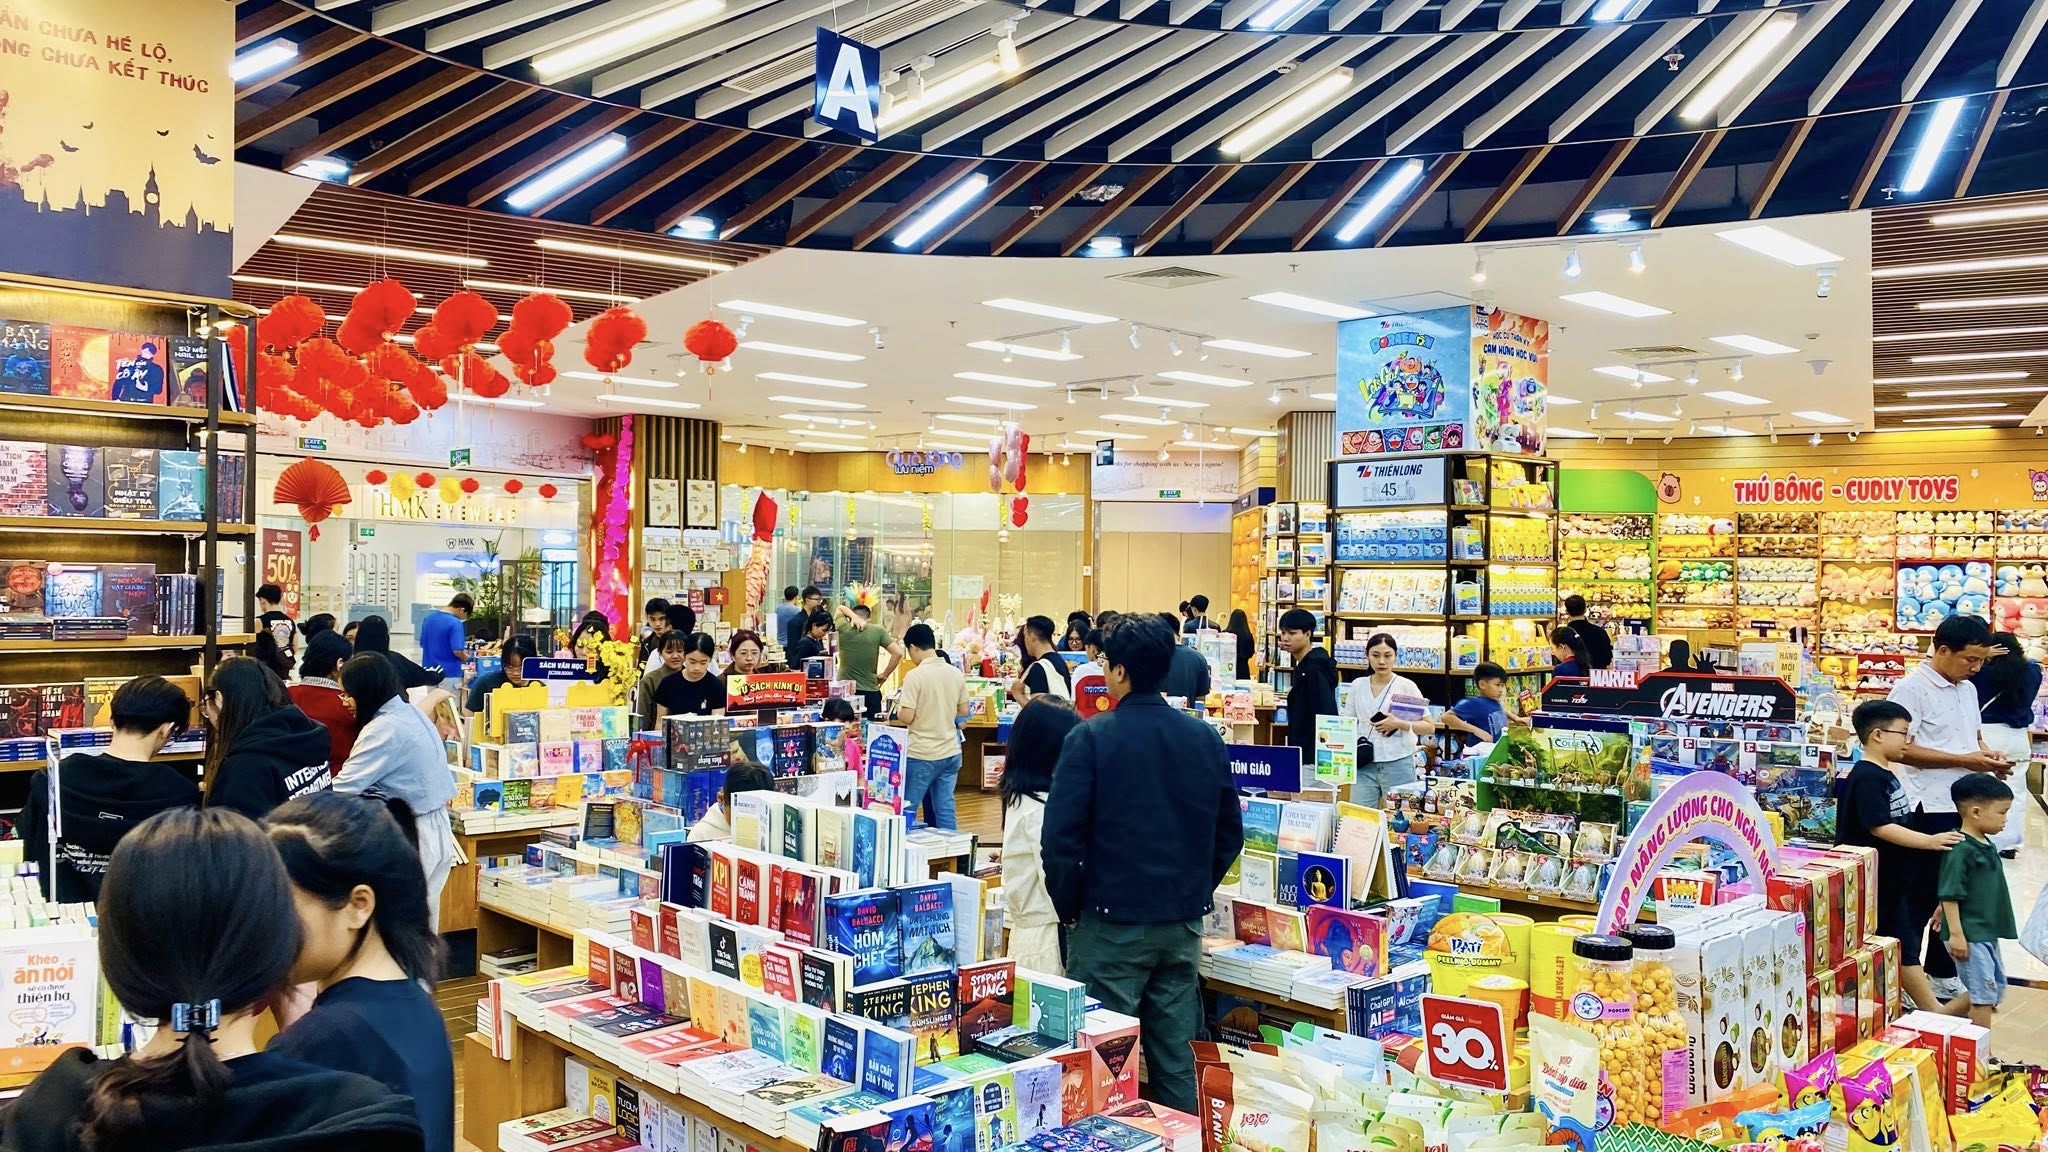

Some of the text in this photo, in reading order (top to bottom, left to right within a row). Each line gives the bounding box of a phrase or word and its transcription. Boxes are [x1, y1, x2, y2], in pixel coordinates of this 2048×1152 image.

[40, 20, 97, 45] CHƯA
[106, 33, 131, 53] HÉ
[41, 46, 209, 94] CHƯA KẾT THÚC
[820, 42, 876, 134] A
[1369, 331, 1435, 354] DORAEMON
[894, 463, 934, 477] lưu niệm
[1380, 481, 1397, 497] 45
[1734, 474, 1769, 502] THÚ
[1774, 474, 1823, 501] BÔNG
[1846, 479, 1904, 501] CUDLY
[1907, 478, 1958, 500] TOYS
[380, 493, 429, 519] HMK
[458, 539, 475, 547] HMK
[266, 554, 297, 583] 50%
[539, 661, 556, 669] SÁCH
[571, 663, 585, 671] HỌC
[773, 681, 792, 691] KINH
[1589, 668, 1639, 689] MARVEL
[1711, 683, 1736, 692] MARVEL
[1660, 682, 1777, 719] AVENGERS
[1231, 759, 1272, 776] TÔN GIÁO
[1630, 822, 1666, 888] NĂNG
[1667, 794, 1708, 834] LƯỢNG
[1710, 794, 1734, 822] CHO
[1734, 808, 1762, 853] NGÀY
[713, 859, 728, 889] KPI
[919, 892, 938, 902] DAVID
[857, 905, 877, 915] DAVID
[914, 901, 944, 913] BALDACCI
[851, 914, 884, 927] BALDACCI
[28, 954, 59, 967] Khéo
[1470, 958, 1502, 967] GUMMY
[42, 962, 75, 982] nói
[970, 968, 1008, 986] STEPHEN
[1555, 956, 1565, 1000] LET'S PARTY
[911, 979, 950, 996] TEPHEN
[972, 980, 1007, 1002] KING
[17, 989, 52, 1005] thiên
[863, 991, 904, 1006] STEPHEN
[863, 1001, 904, 1020] KING
[911, 1014, 953, 1028] GUNSLINGER
[1370, 1011, 1382, 1028] AI
[1431, 1022, 1499, 1072] 30%
[881, 1079, 895, 1093] THỨC
[617, 1108, 639, 1127] LOGIC
[1240, 1112, 1271, 1128] JOJO
